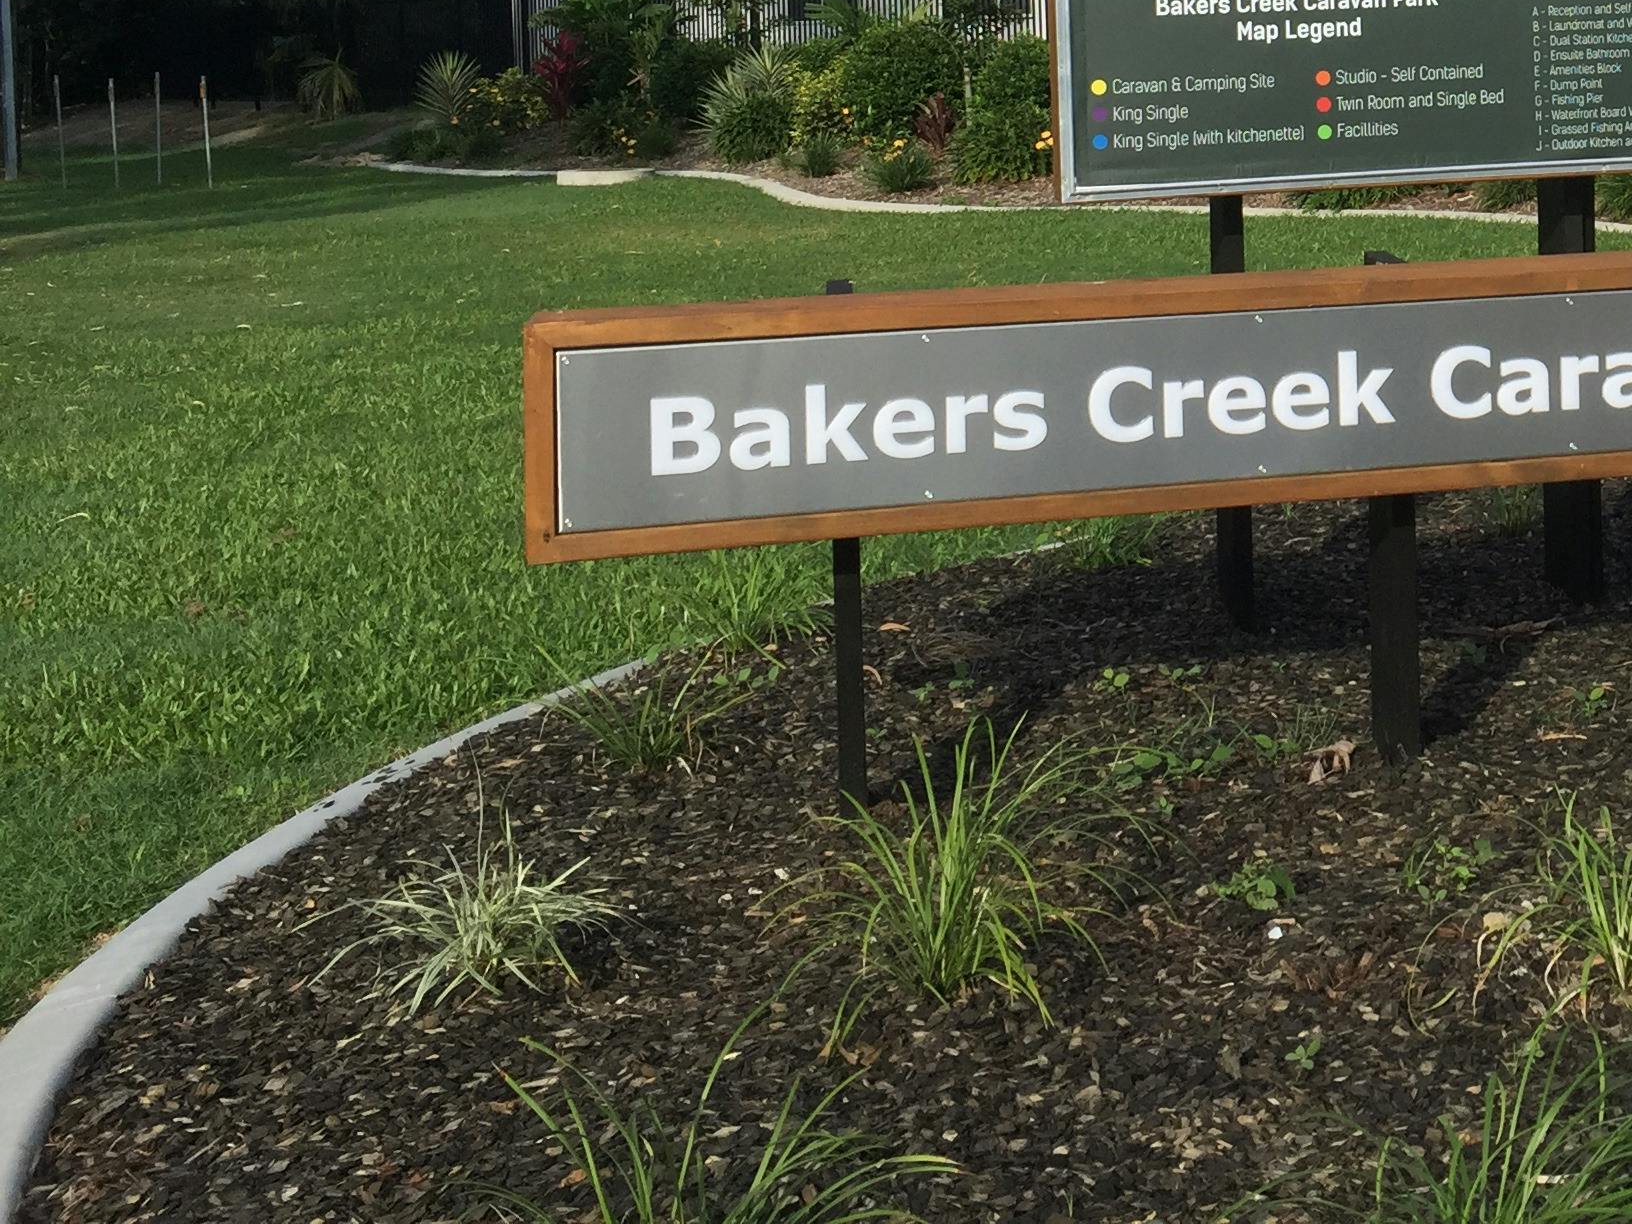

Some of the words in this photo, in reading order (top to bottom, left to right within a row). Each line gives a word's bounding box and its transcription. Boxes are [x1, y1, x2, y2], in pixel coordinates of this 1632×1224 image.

[1548, 5, 1592, 17] Reception
[1594, 3, 1612, 14] and
[1614, 3, 1631, 14] Self
[1237, 21, 1278, 44] Map
[1286, 17, 1361, 43] Legend
[1549, 19, 1604, 31] Laundromat
[1607, 18, 1624, 28] and
[1550, 35, 1570, 46] Dual
[1573, 34, 1604, 45] Station
[1551, 49, 1584, 61] Ensuite
[1586, 48, 1630, 59] Bathroom
[1336, 69, 1376, 84] Studio
[1391, 67, 1415, 82] Self
[1420, 64, 1483, 80] Contained
[1550, 64, 1595, 75] Amenities
[1597, 63, 1621, 73] Block
[1113, 79, 1167, 94] Caravan
[1172, 77, 1181, 91] &
[1186, 75, 1246, 92] Camping
[1250, 73, 1274, 88] Site
[1550, 80, 1578, 91] Dump
[1581, 78, 1602, 89] Point
[1336, 97, 1363, 111] Twin
[1368, 95, 1404, 109] Room
[1409, 92, 1433, 107] and
[1437, 91, 1476, 109] Single
[1480, 89, 1504, 104] Bed
[1552, 94, 1584, 107] Fishing
[1587, 93, 1603, 103] Pier
[1113, 107, 1142, 124] King
[1146, 104, 1188, 123] Single
[1551, 108, 1598, 120] Waterfront
[1600, 106, 1626, 118] Board
[1552, 123, 1588, 135] Grassed
[1591, 122, 1623, 134] Fishing
[1114, 134, 1143, 151] King
[1147, 132, 1189, 150] Single
[1552, 139, 1587, 150] Outdoor
[1590, 137, 1623, 147] Kitchen
[650, 384, 1047, 475] Bakers
[1088, 351, 1395, 442] Creek
